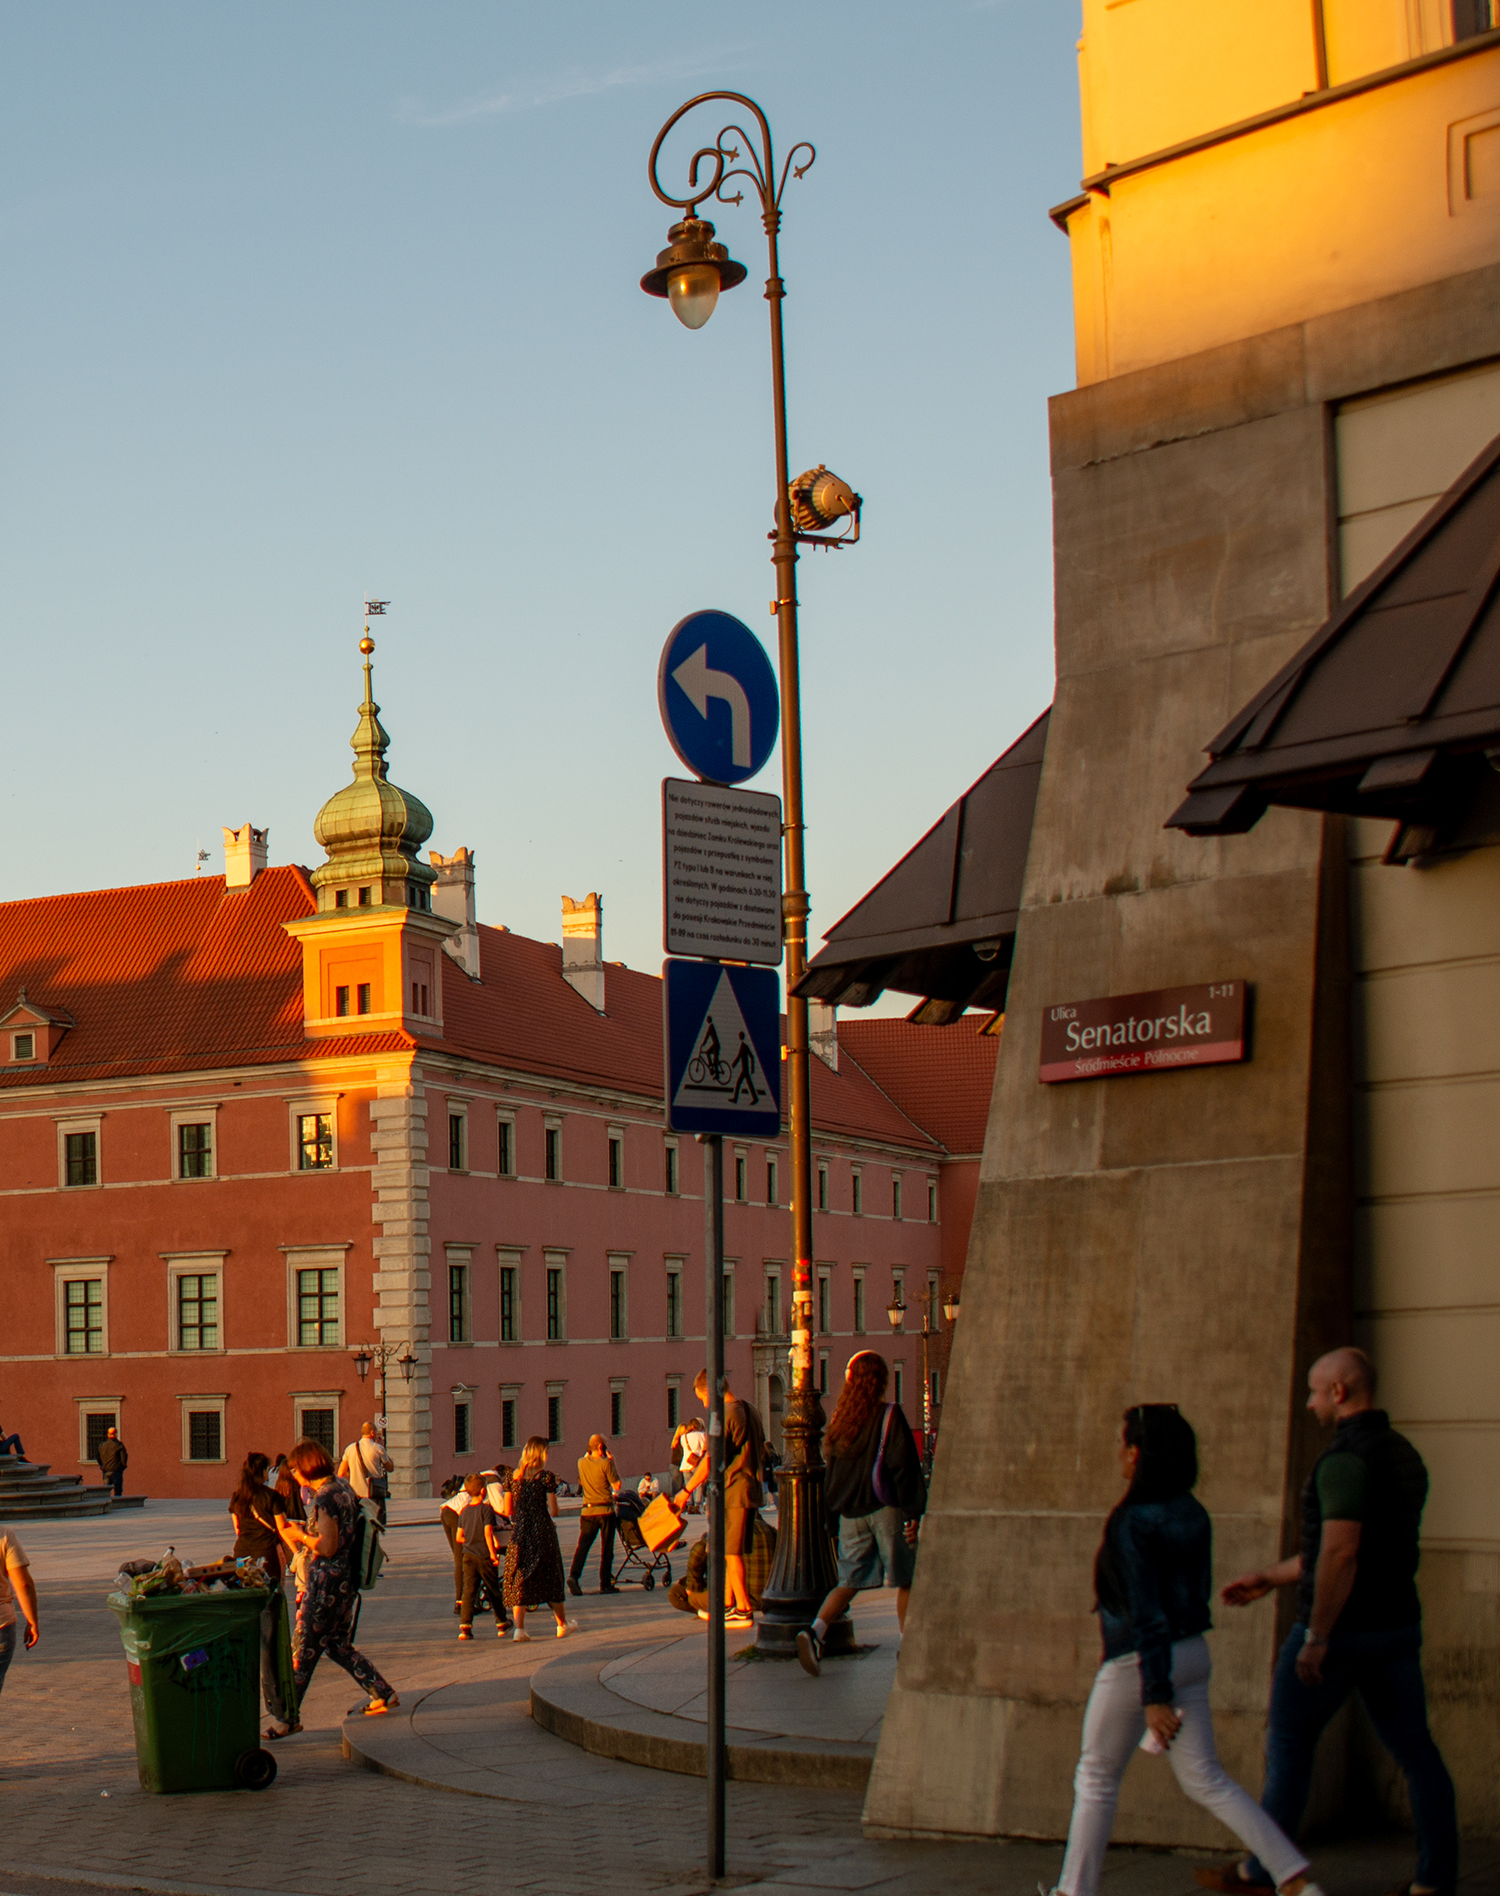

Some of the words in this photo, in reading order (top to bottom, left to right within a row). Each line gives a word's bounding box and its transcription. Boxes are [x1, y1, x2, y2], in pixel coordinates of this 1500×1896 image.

[668, 793, 678, 802] Nie
[679, 795, 703, 808] dotyczy
[705, 799, 730, 810] rowerów
[674, 811, 703, 824] pojazdów
[750, 822, 770, 834] wjazdu
[707, 832, 726, 843] Zamku
[727, 834, 765, 850] Królewskiego
[766, 842, 778, 850] oraz
[673, 844, 702, 856] pojazdów
[707, 848, 739, 861] przepustką
[745, 853, 773, 866] symbolem
[673, 861, 681, 869] PZ
[682, 862, 696, 873] typu
[700, 864, 708, 873] lub
[710, 866, 714, 874] B
[724, 868, 755, 880] warunkach
[762, 874, 772, 883] niej
[718, 883, 747, 896] godzinach
[674, 895, 684, 903] nie
[685, 896, 709, 908] dotyczy
[710, 899, 738, 911] pojazdów
[743, 903, 775, 915] dostawami
[703, 915, 737, 926] Krakowskie
[709, 932, 742, 944] rozładunku
[743, 937, 751, 945] do
[751, 937, 759, 945] 30
[1208, 983, 1235, 999] 1-11
[1051, 1006, 1077, 1021] Ulica
[1065, 1003, 1212, 1052] Senatorska
[1074, 1053, 1141, 1075] Śródmieście
[1144, 1048, 1199, 1066] Północne
